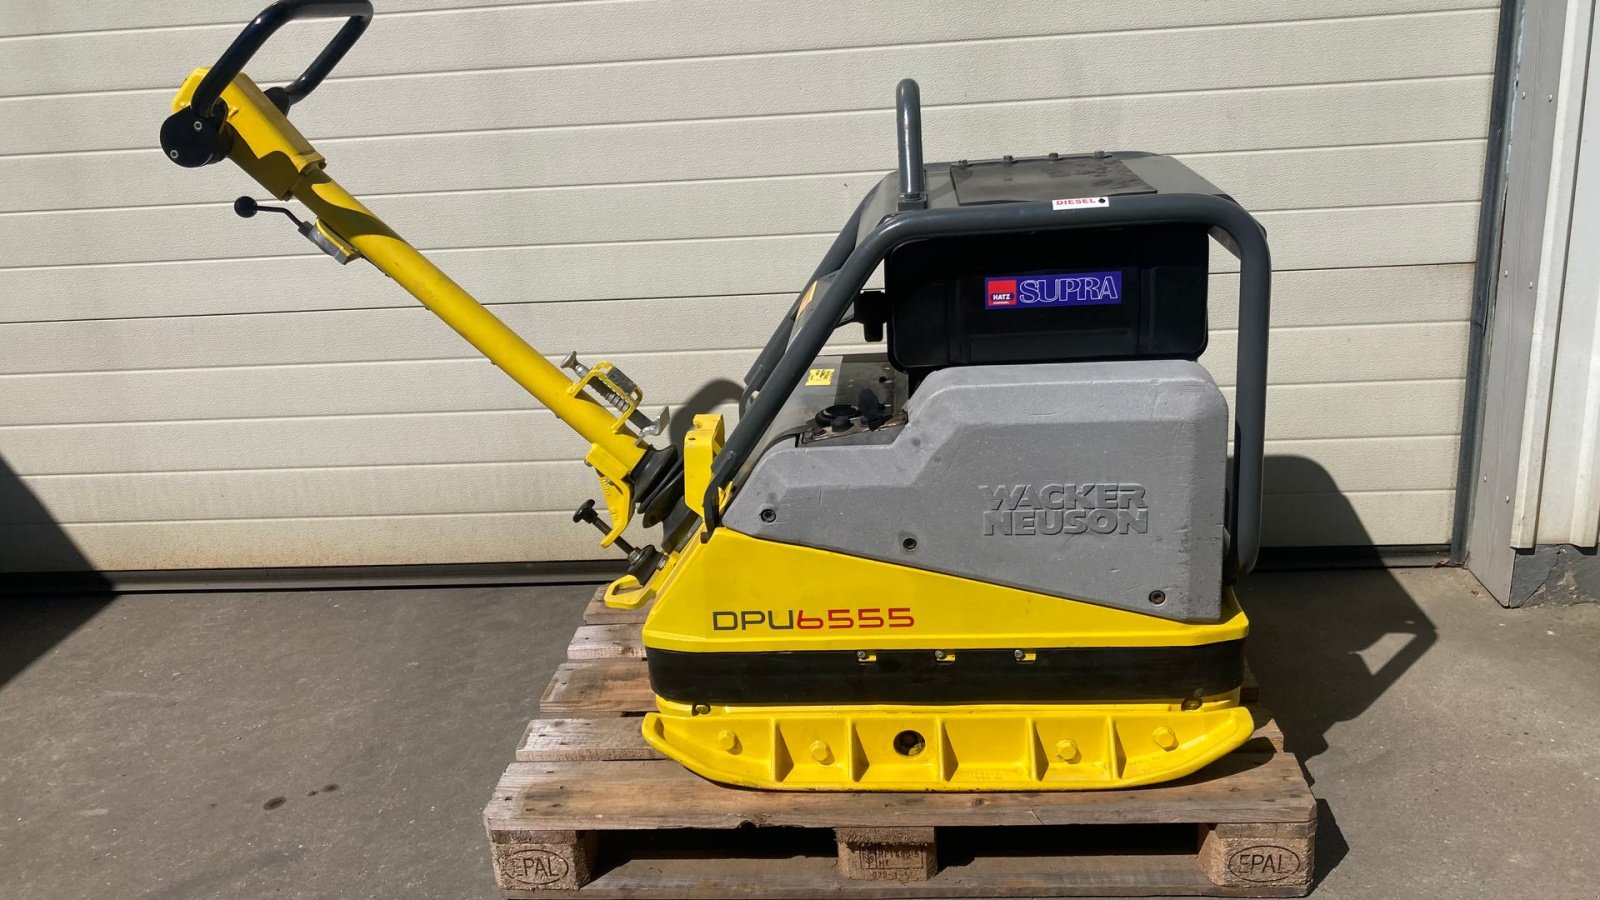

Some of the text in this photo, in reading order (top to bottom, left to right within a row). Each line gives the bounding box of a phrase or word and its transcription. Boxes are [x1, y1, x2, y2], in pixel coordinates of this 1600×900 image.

[1055, 198, 1096, 206] DIESEL
[992, 293, 1011, 301] HATZ
[1019, 276, 1118, 303] SUPRA
[978, 483, 1148, 510] WACKER
[983, 509, 1148, 536] NEUSON
[712, 607, 915, 631] DPU6555
[1238, 854, 1289, 874] EPAL
